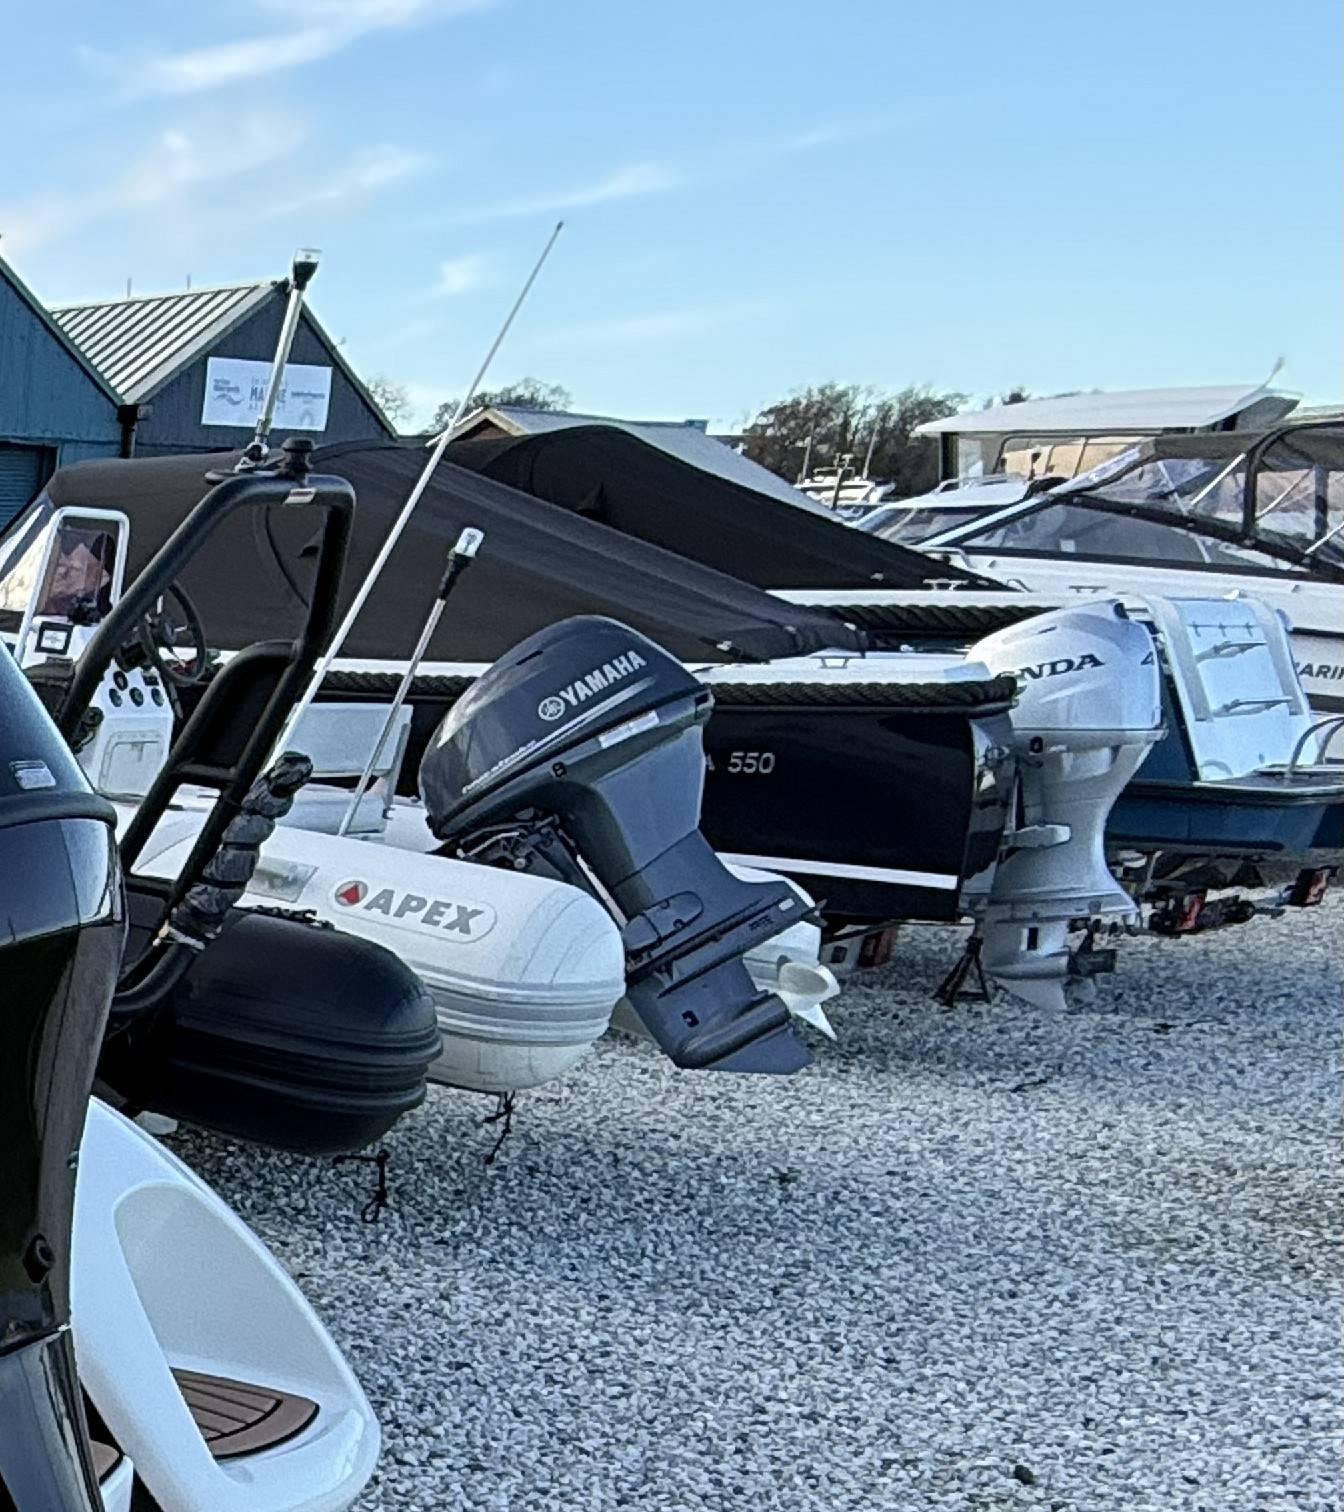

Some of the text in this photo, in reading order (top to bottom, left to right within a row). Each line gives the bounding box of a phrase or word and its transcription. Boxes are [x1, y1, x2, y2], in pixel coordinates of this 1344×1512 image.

[559, 650, 647, 706] YAMAHA
[995, 653, 1105, 682] NDA
[1295, 662, 1344, 680] ARI
[727, 752, 775, 774] 550
[363, 888, 484, 935] APEX
